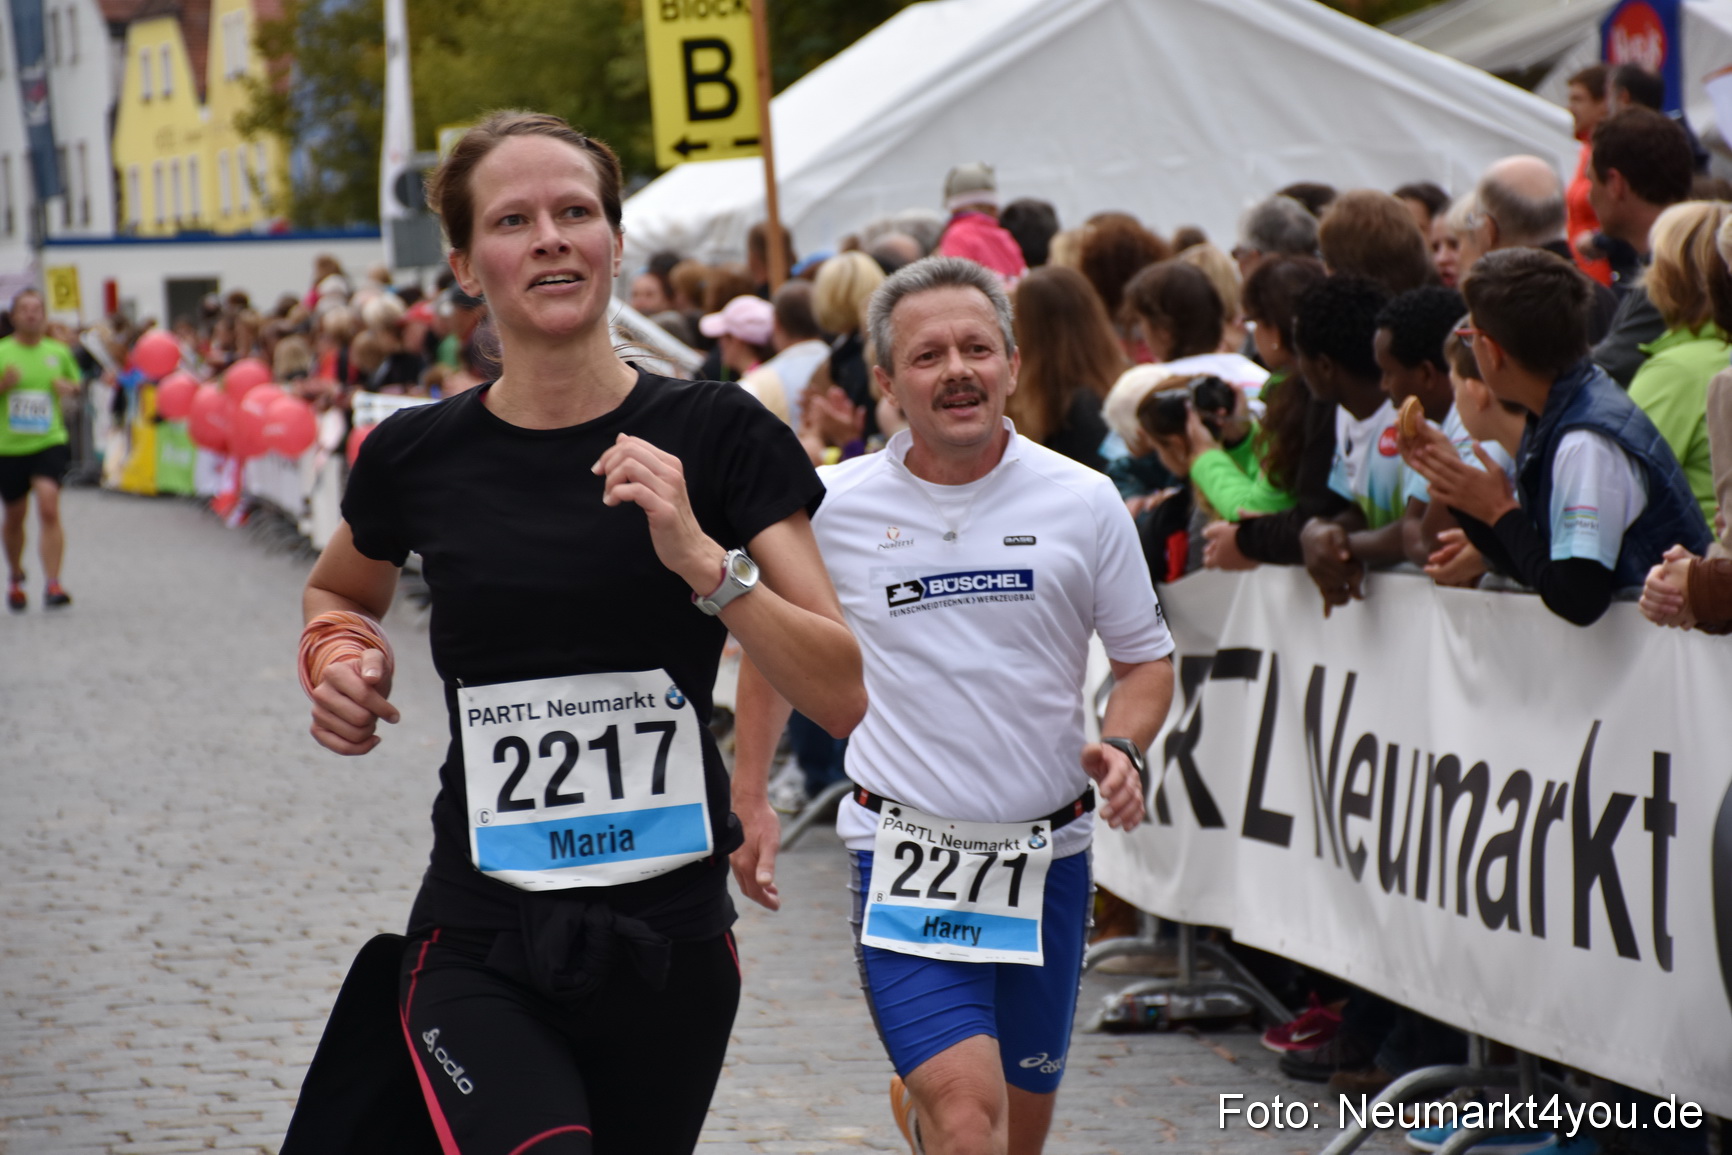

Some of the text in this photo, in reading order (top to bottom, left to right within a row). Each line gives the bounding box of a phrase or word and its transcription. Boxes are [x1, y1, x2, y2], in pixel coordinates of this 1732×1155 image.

[681, 37, 740, 122] B
[928, 573, 1028, 595] BÜSCHEL
[468, 691, 656, 727] PARTL Neumarkt
[492, 720, 677, 813] 2217
[480, 811, 490, 824] C
[882, 817, 1021, 852] PARTL Neumarkt
[1304, 664, 1677, 973] Neumarkt
[549, 824, 635, 860] Maria
[889, 840, 1029, 908] 2271
[923, 915, 982, 946] Harry
